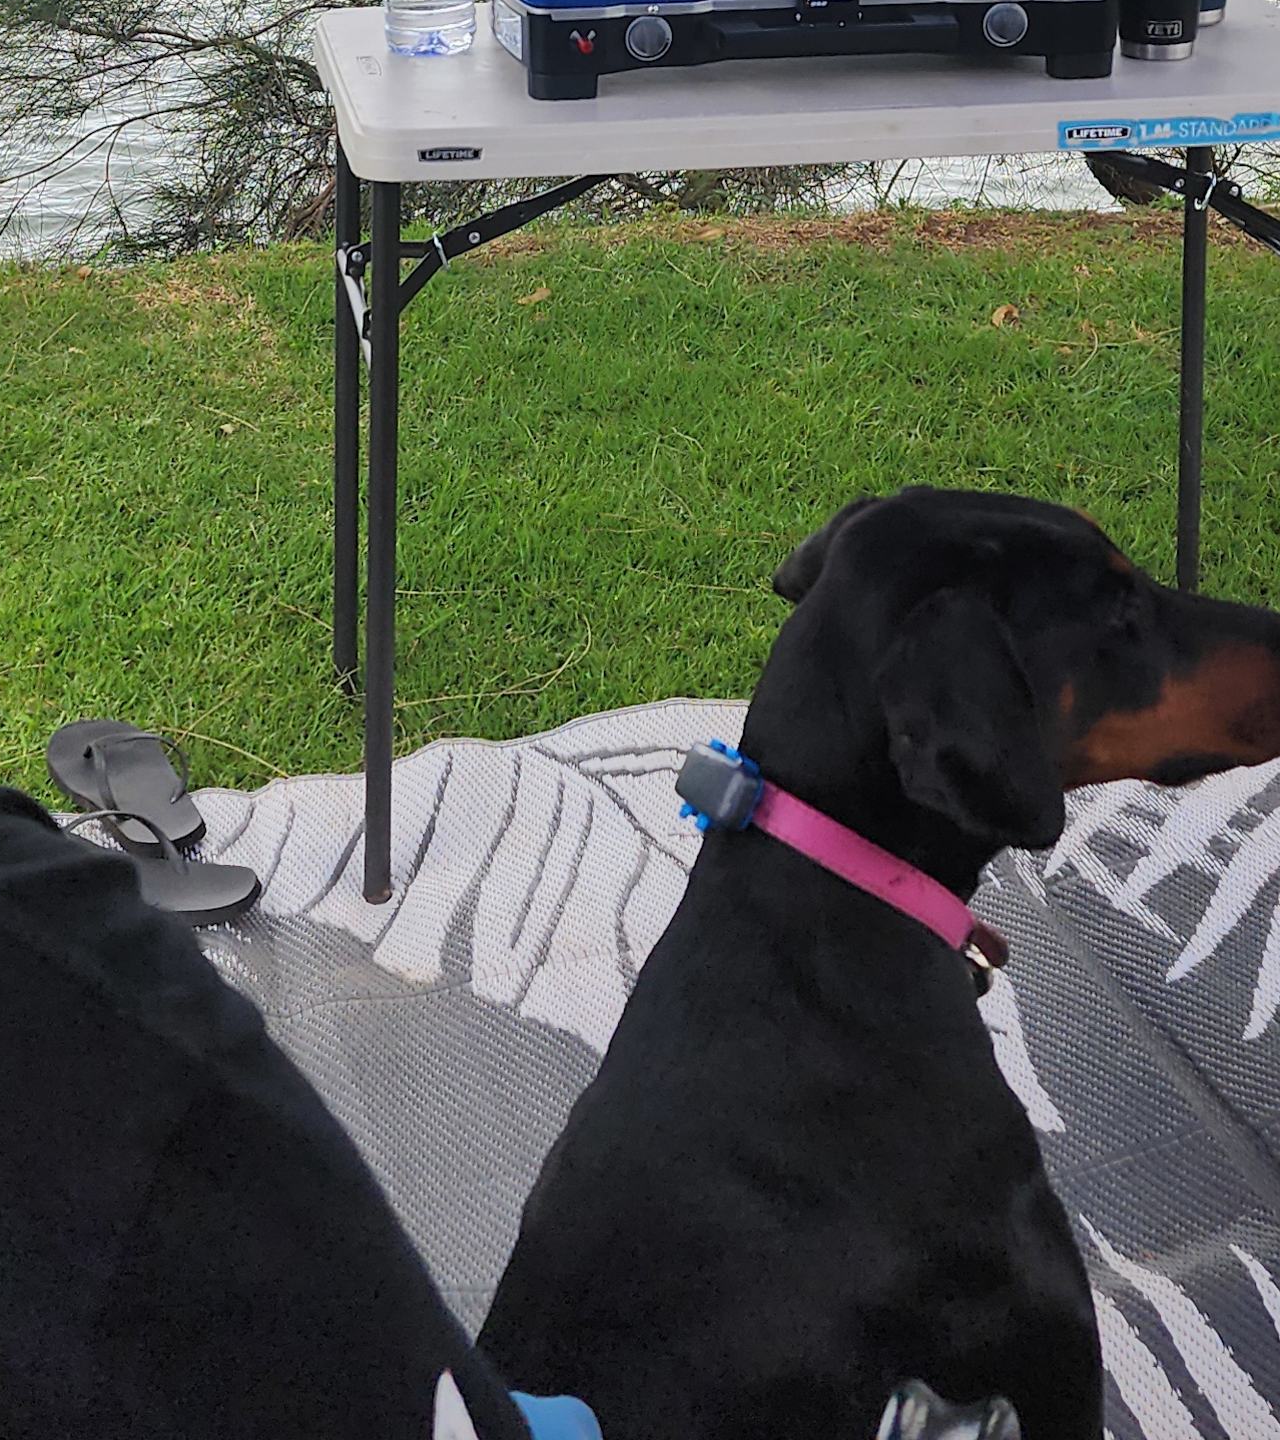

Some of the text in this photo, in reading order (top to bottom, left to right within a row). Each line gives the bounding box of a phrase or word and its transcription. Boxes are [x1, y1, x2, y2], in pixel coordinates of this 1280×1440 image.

[1147, 23, 1179, 35] YETI
[1072, 127, 1123, 138] LIFETIME
[425, 149, 475, 160] LIFETIME
